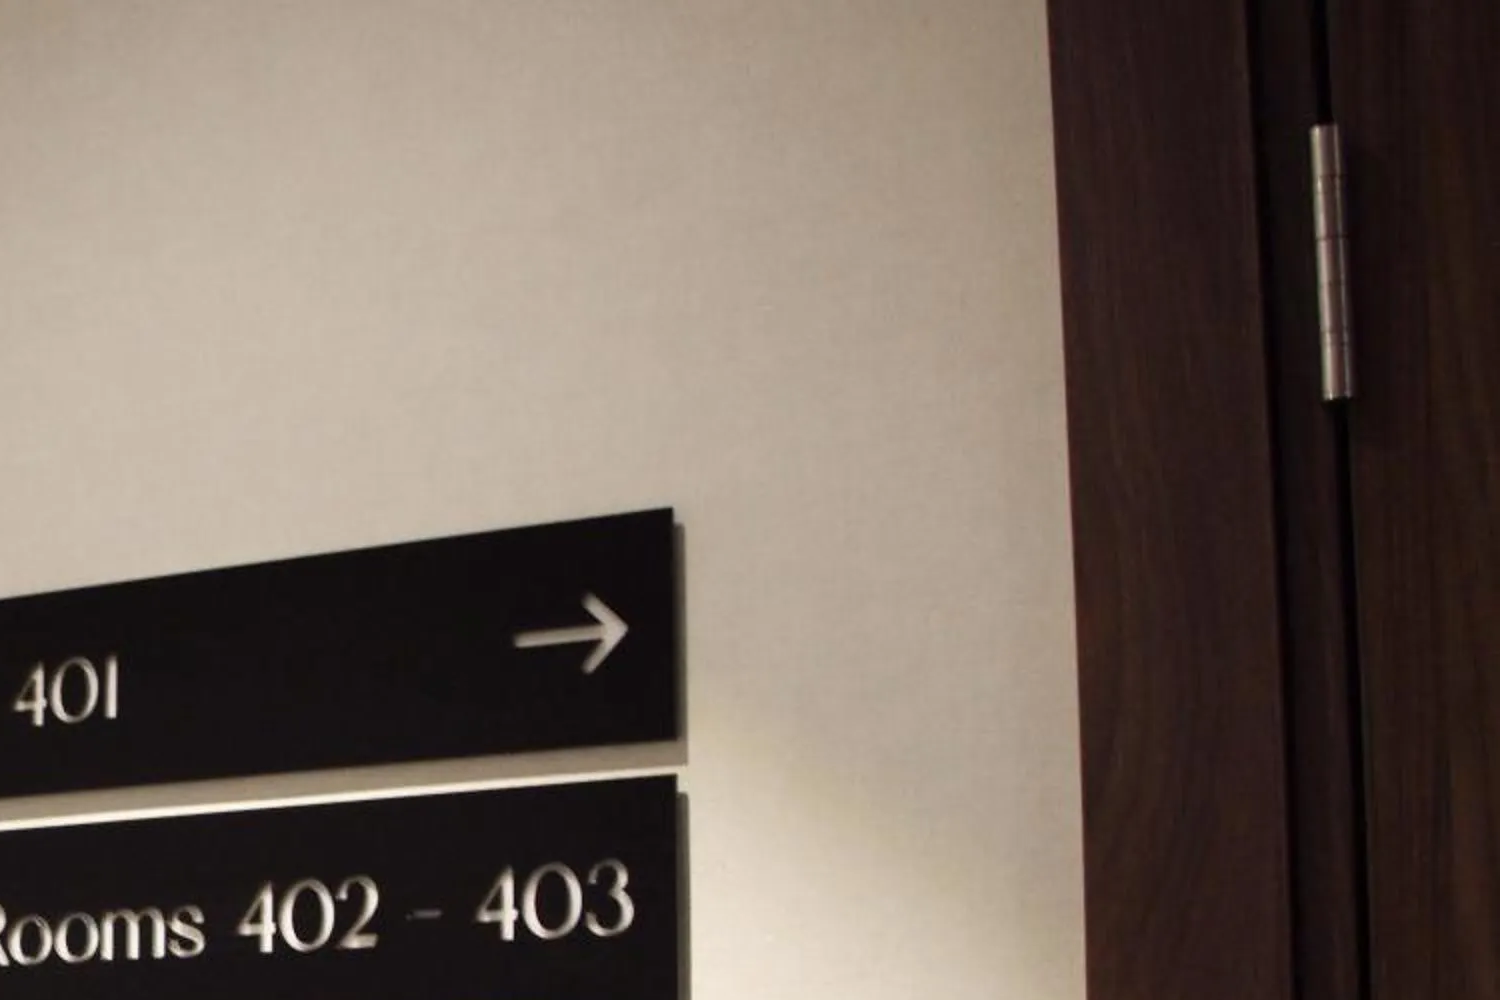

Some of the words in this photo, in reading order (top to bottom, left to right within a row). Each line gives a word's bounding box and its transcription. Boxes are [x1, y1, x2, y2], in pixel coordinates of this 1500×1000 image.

[13, 655, 119, 728] 401
[236, 876, 380, 955] 402
[475, 860, 635, 942] 403
